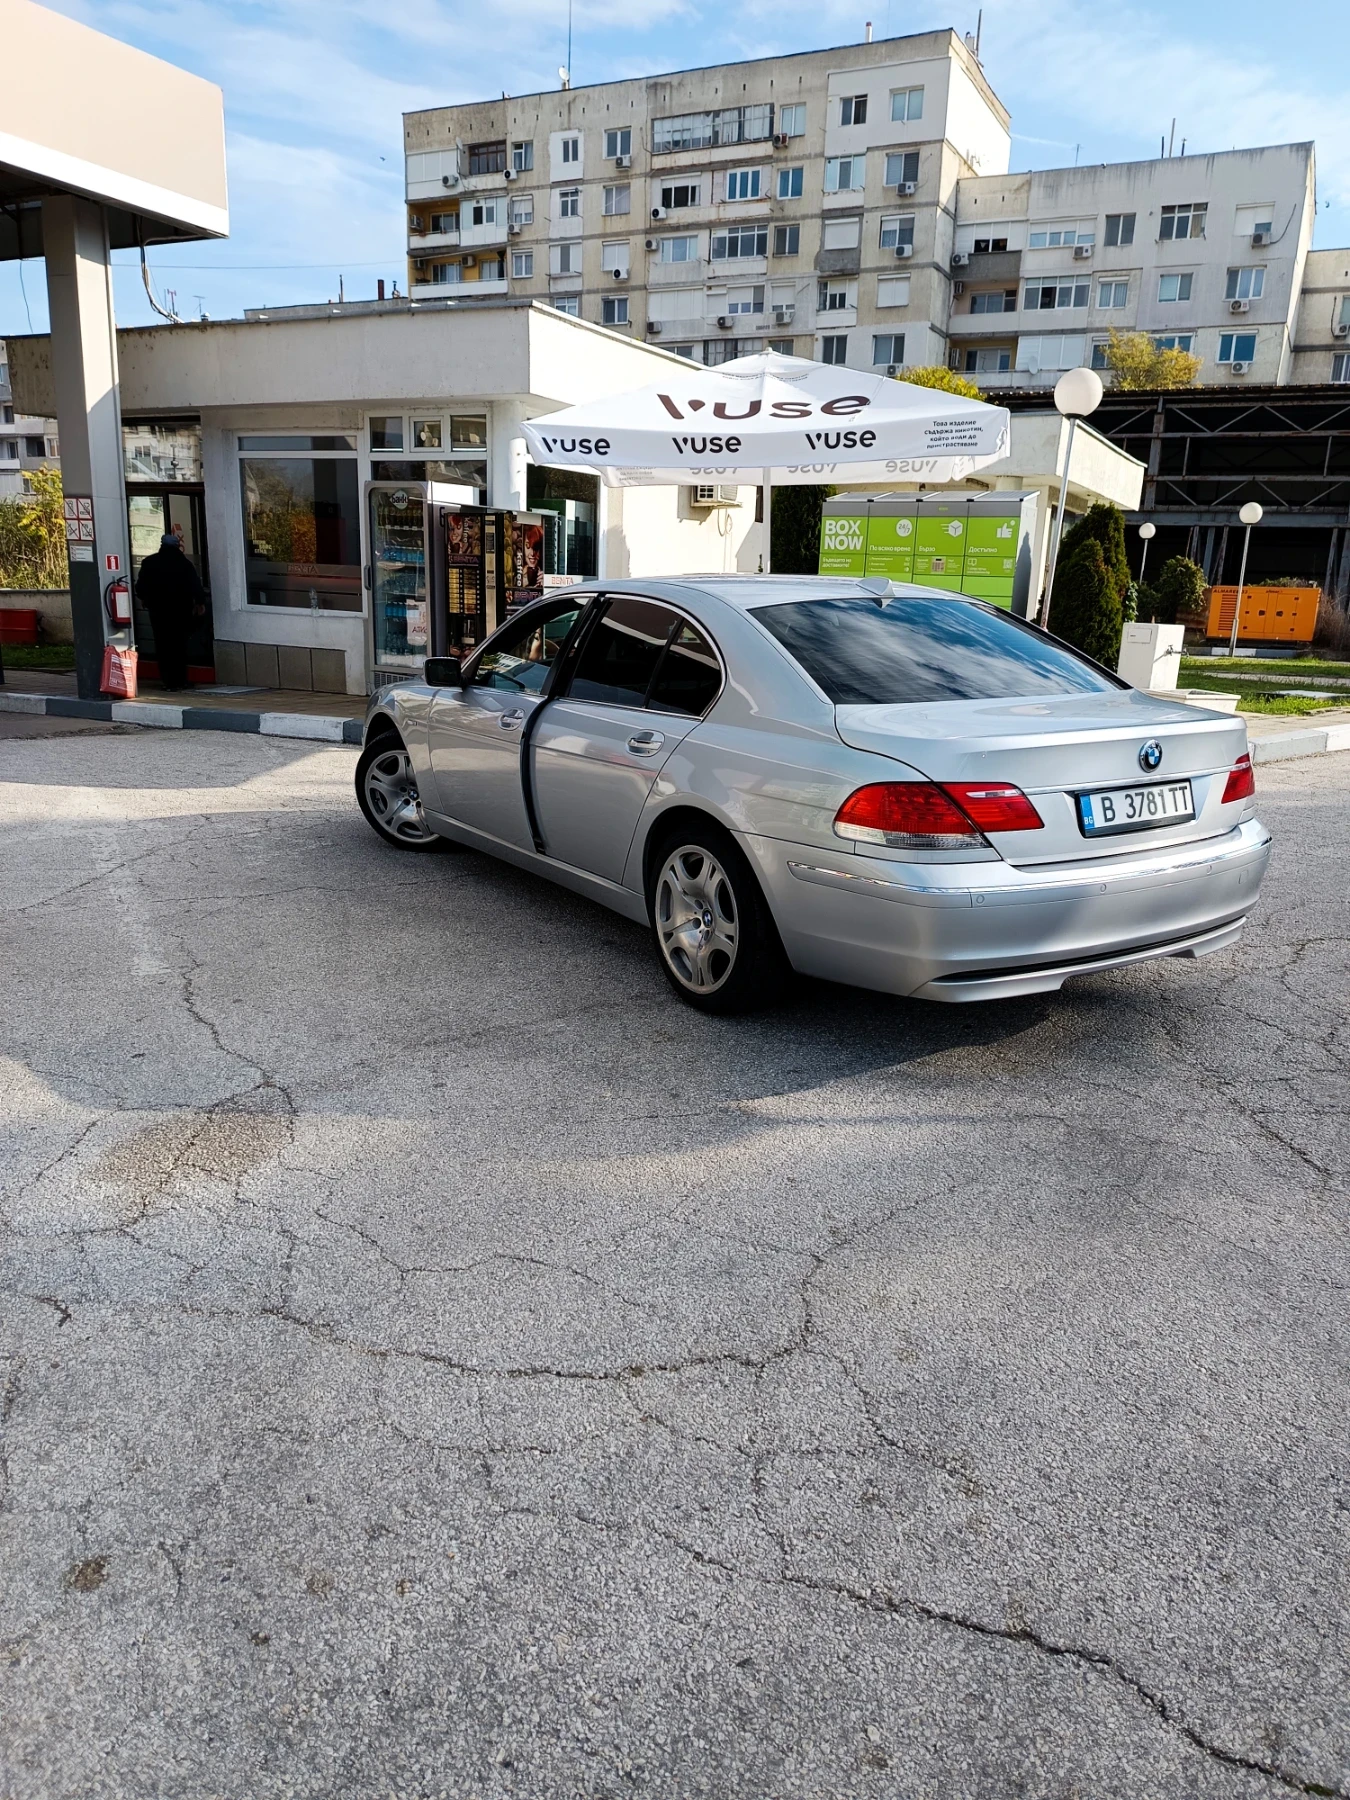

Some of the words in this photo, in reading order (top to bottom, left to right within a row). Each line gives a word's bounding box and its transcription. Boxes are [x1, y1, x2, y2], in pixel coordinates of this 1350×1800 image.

[825, 519, 862, 535] BOX
[823, 535, 864, 551] NOW
[1101, 795, 1116, 823] B
[1084, 816, 1093, 825] BG
